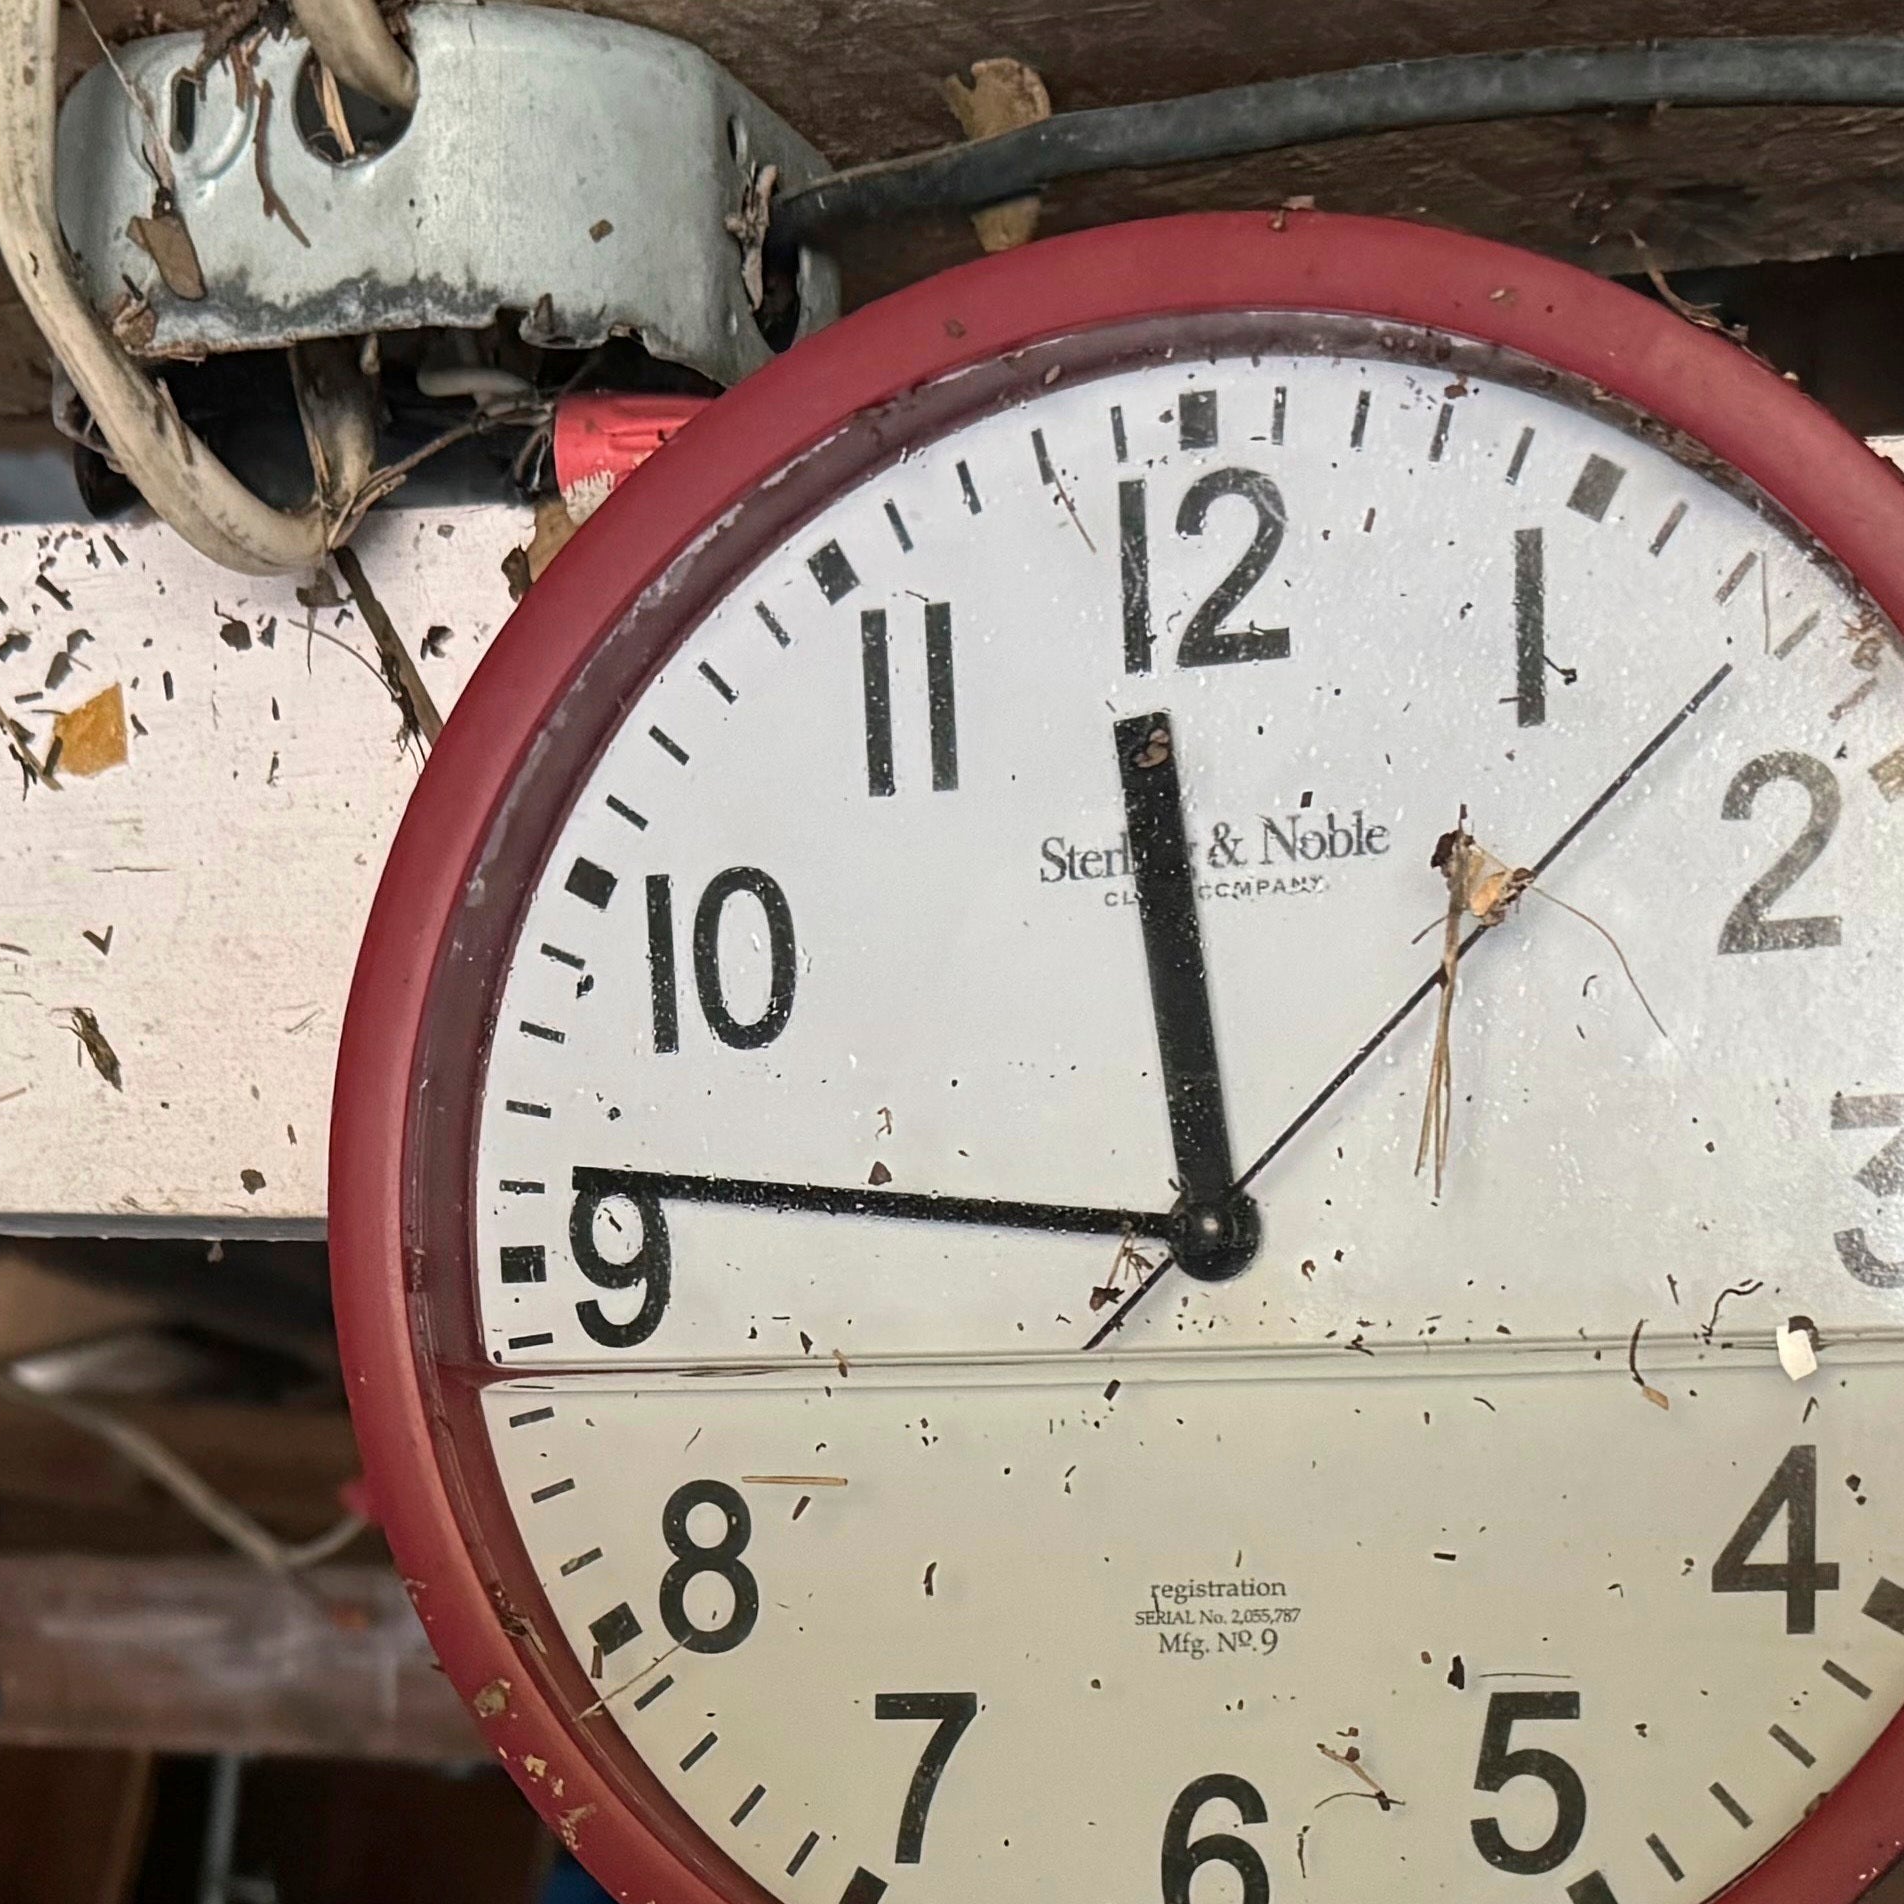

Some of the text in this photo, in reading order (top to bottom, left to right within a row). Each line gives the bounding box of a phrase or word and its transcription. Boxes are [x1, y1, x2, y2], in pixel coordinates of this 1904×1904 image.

[1119, 467, 1291, 674] 12
[1513, 527, 1547, 727] 1
[860, 601, 959, 797] 11
[1040, 810, 1390, 883] Sterl & Noble
[1716, 750, 1843, 956] 2
[645, 866, 798, 1055] 10
[569, 1172, 671, 1348] 9
[658, 1479, 760, 1655] 8
[1135, 1607, 1302, 1626] SERIAL No. 2,055,787
[1150, 1577, 1287, 1604] registration
[1711, 1444, 1841, 1635] 4
[1158, 1631, 1211, 1660] Mfg.
[874, 1691, 978, 1864] 7
[1470, 1690, 1587, 1876] 5
